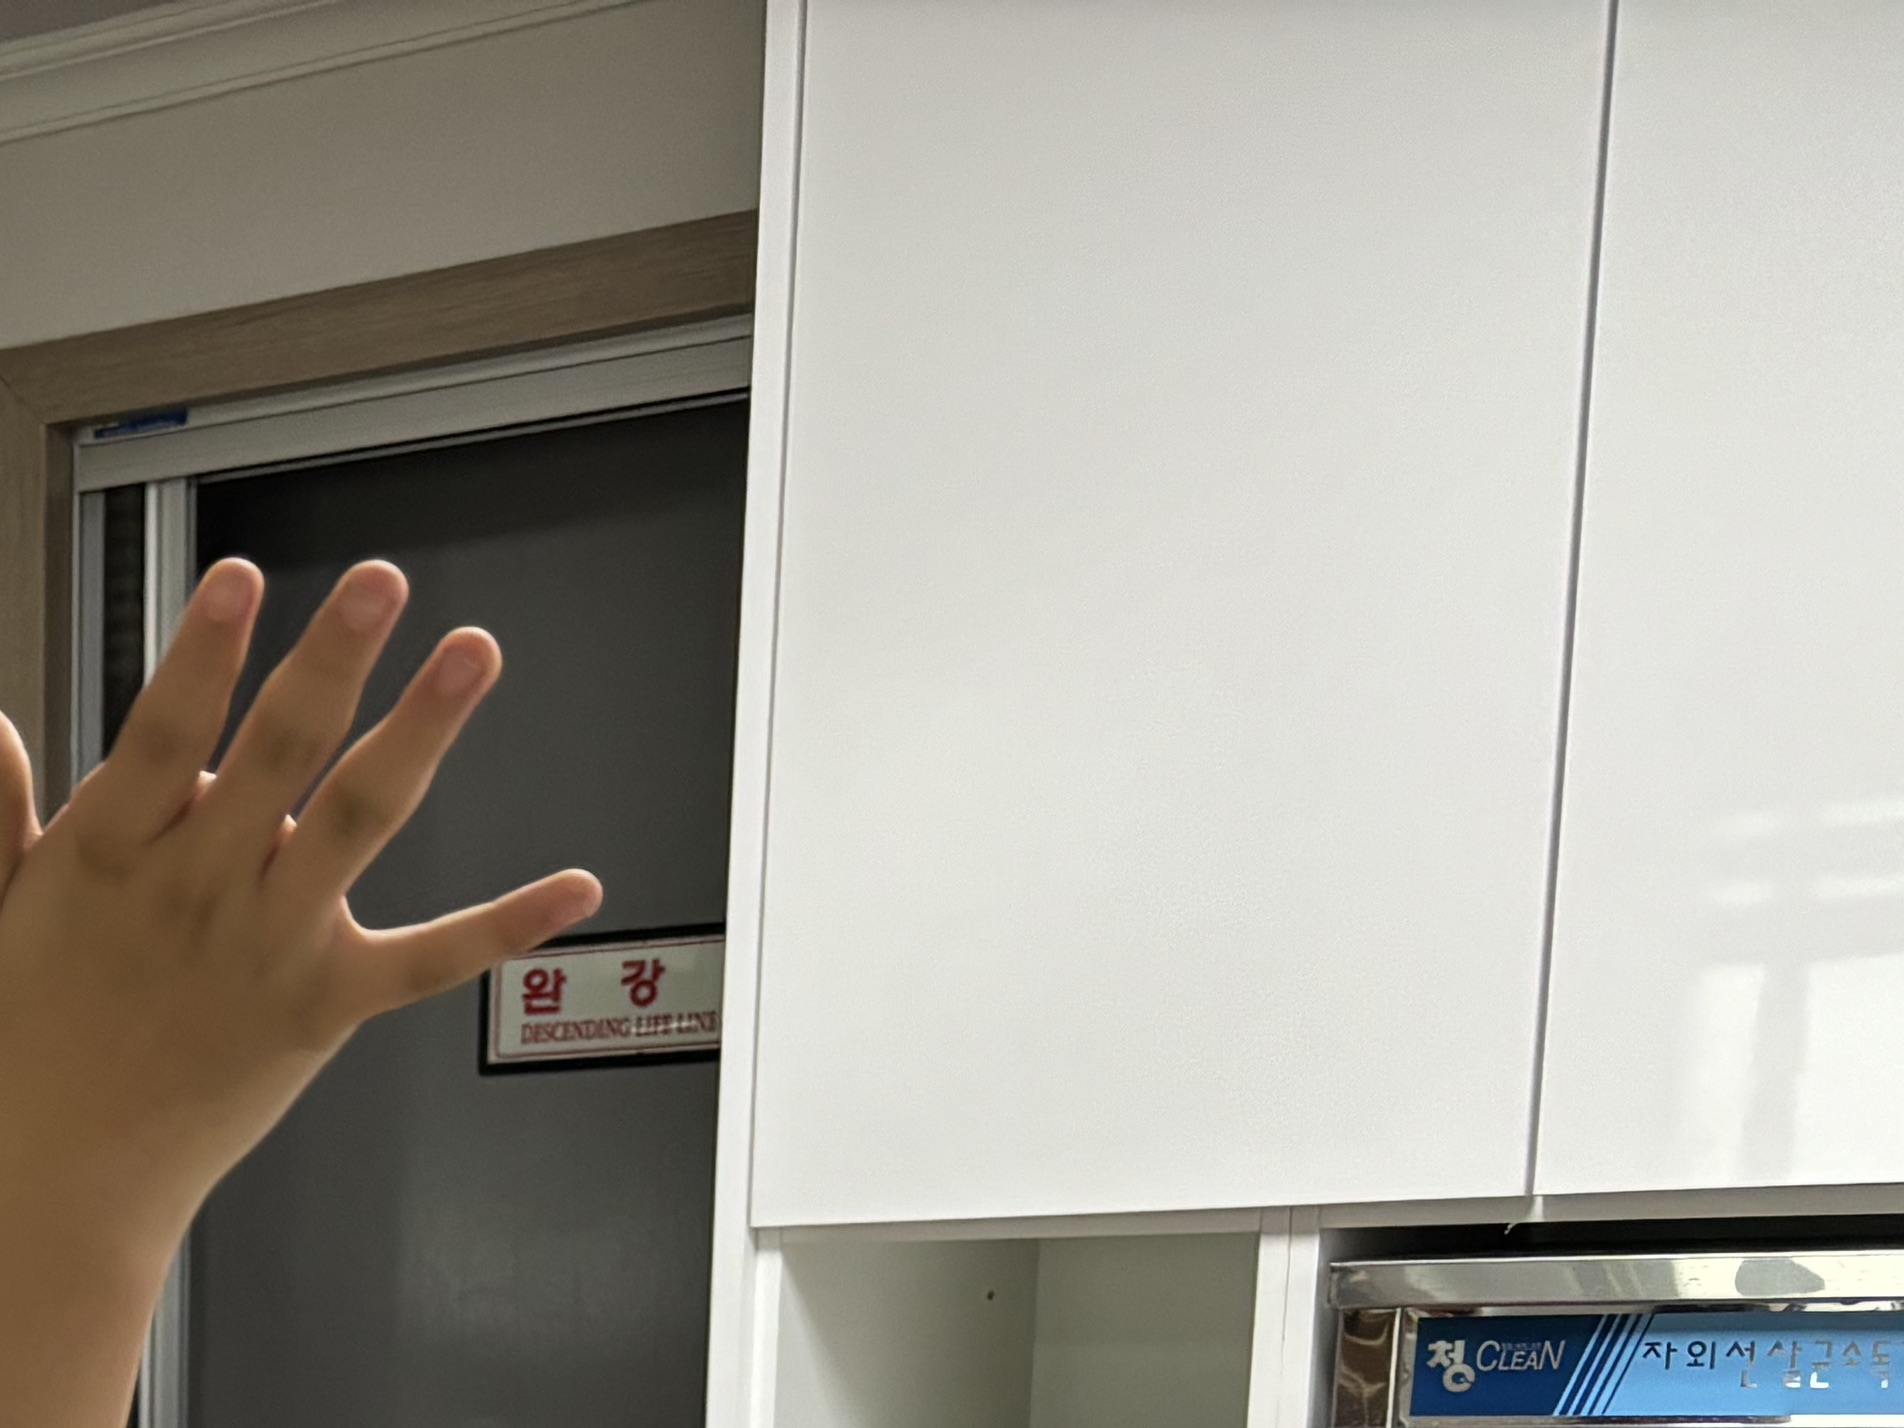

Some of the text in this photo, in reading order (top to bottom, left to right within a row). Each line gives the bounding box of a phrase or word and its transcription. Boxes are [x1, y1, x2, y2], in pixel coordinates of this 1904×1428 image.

[620, 958, 666, 1008] 강
[520, 1009, 717, 1045] DESCENDING LIFE LINE
[1426, 1339, 1476, 1393] 청
